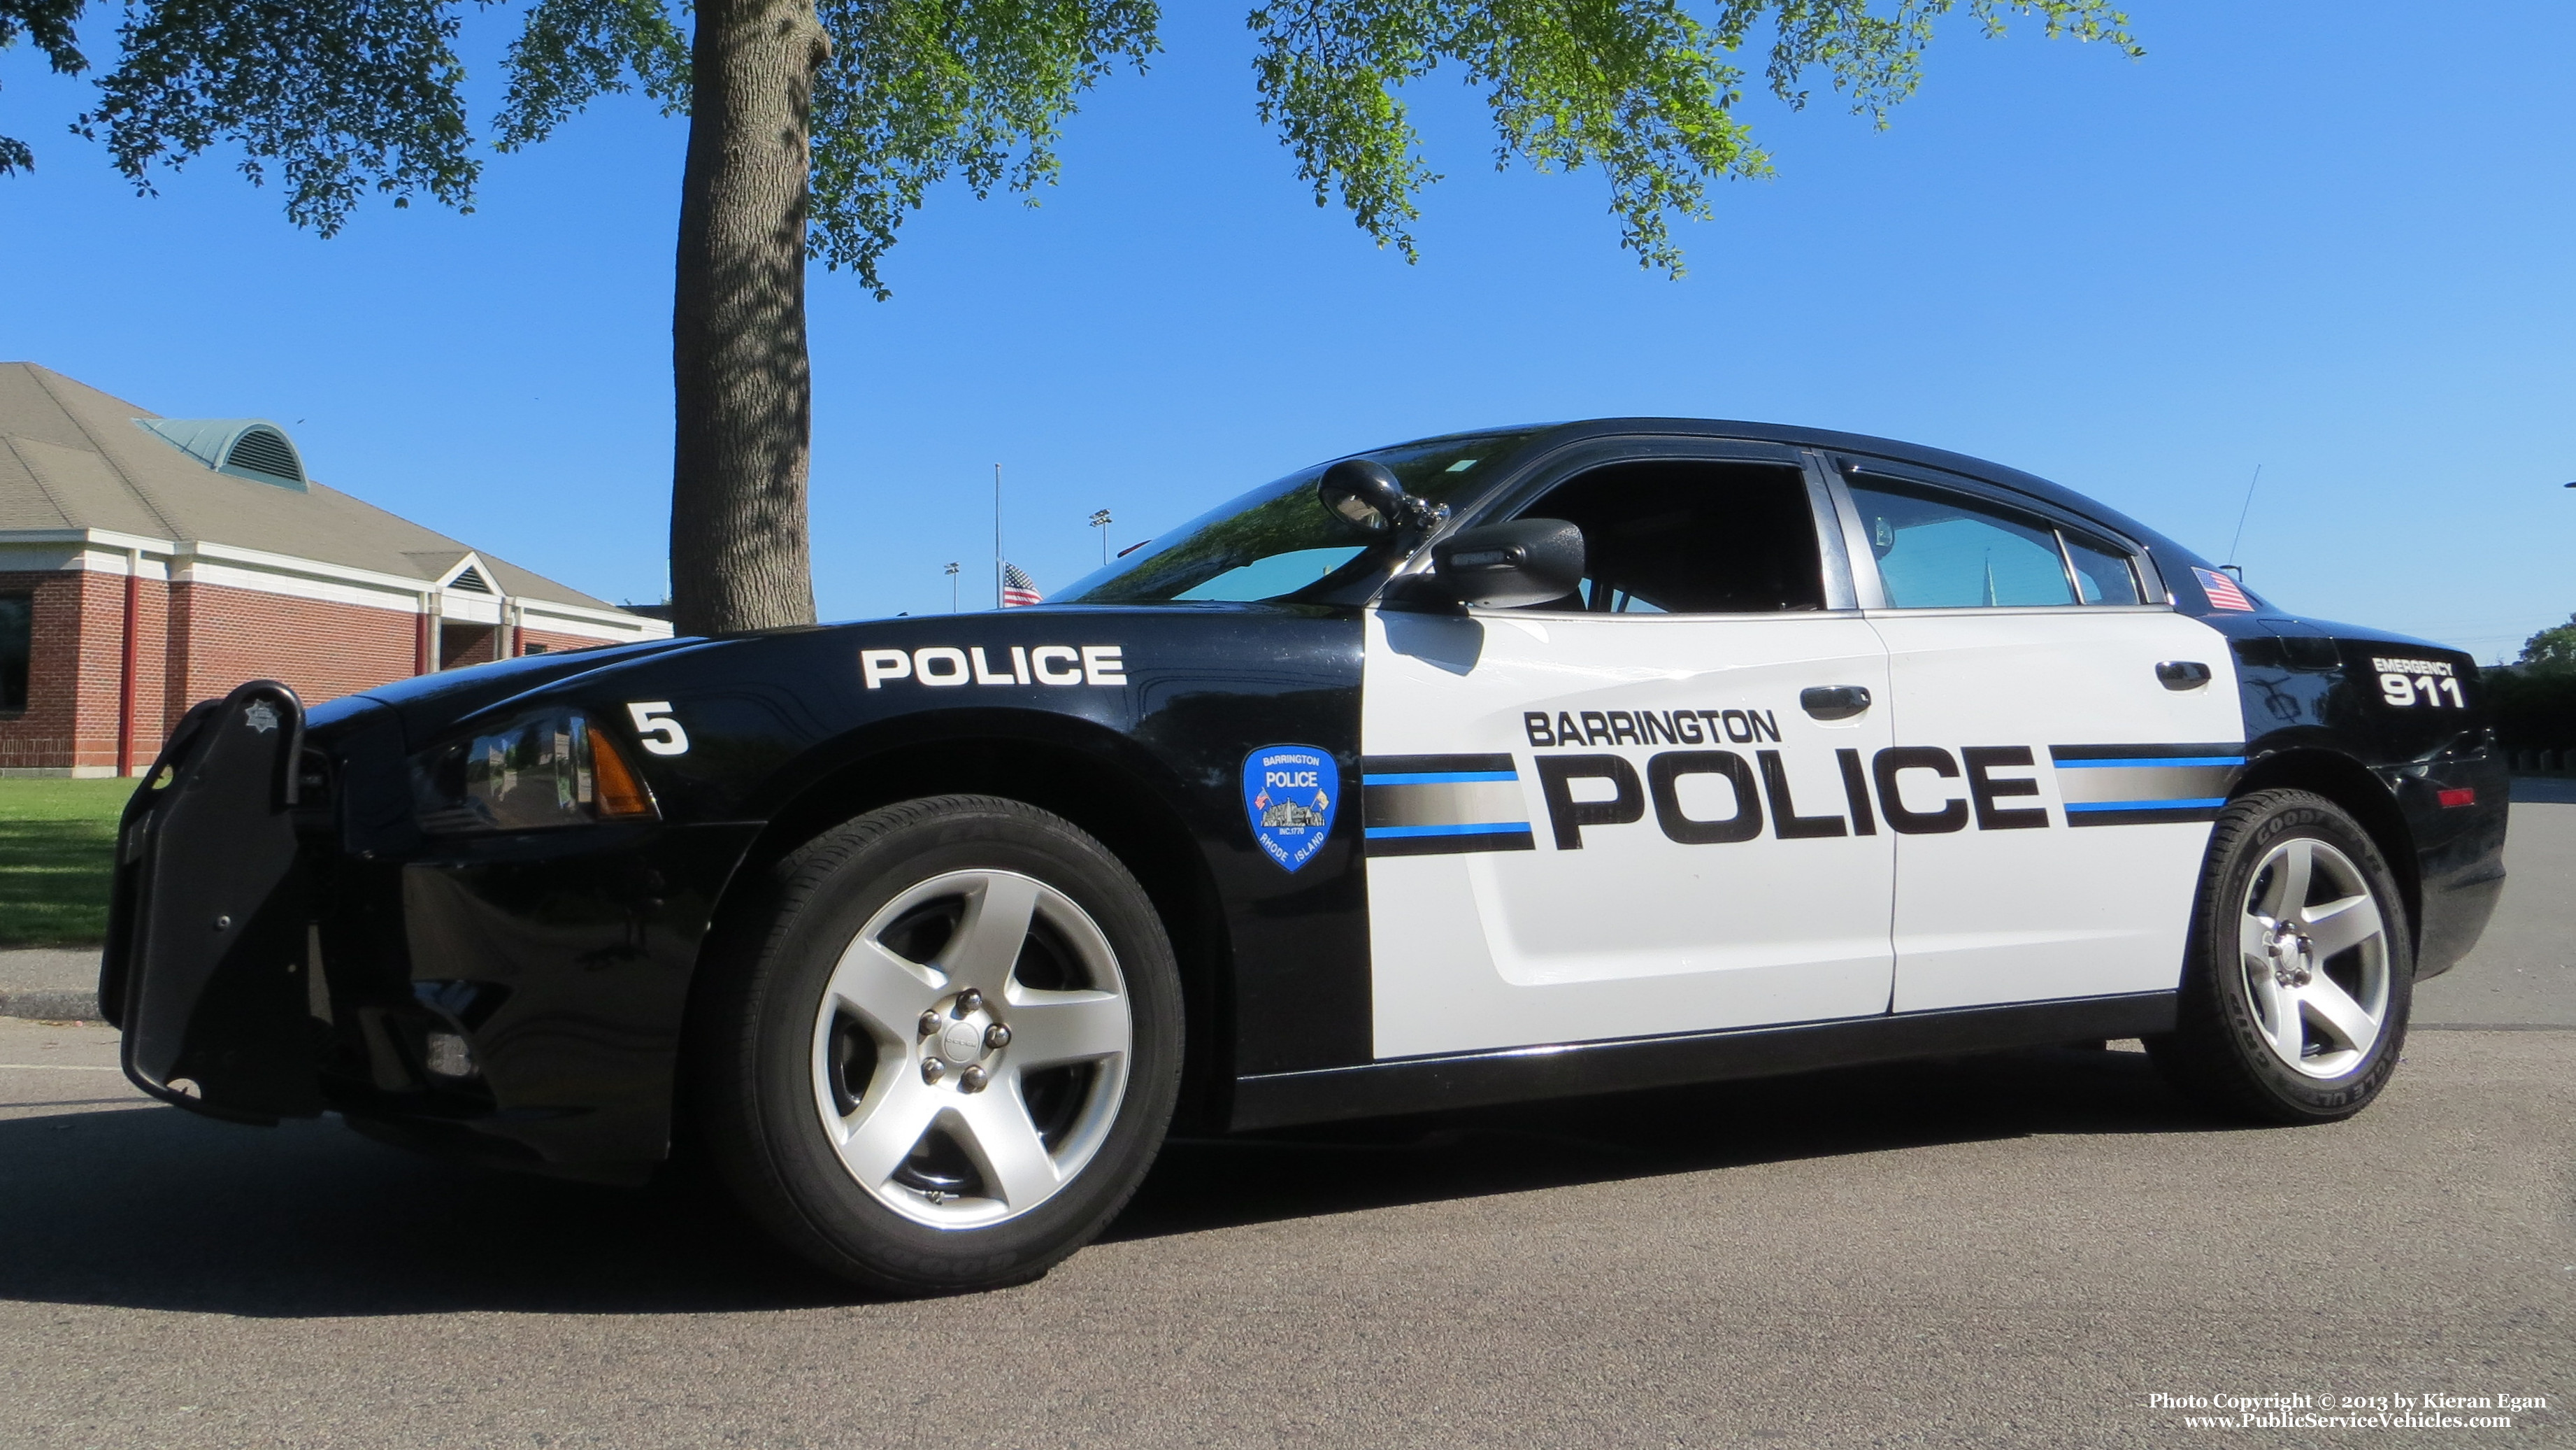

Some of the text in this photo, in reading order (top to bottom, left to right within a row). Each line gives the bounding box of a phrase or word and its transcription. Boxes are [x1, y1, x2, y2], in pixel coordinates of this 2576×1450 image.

[861, 645, 1128, 690] POLICE
[2372, 657, 2454, 676] EMERGENCY
[2379, 673, 2464, 708] 911
[627, 701, 689, 757] 5
[1524, 709, 1782, 746] BARRINGTON
[1262, 754, 1320, 767] BARRINGTON
[1266, 772, 1318, 788] POLICE
[1533, 745, 2049, 851] POLICE
[1259, 831, 1325, 862] RHODE ISLAND
